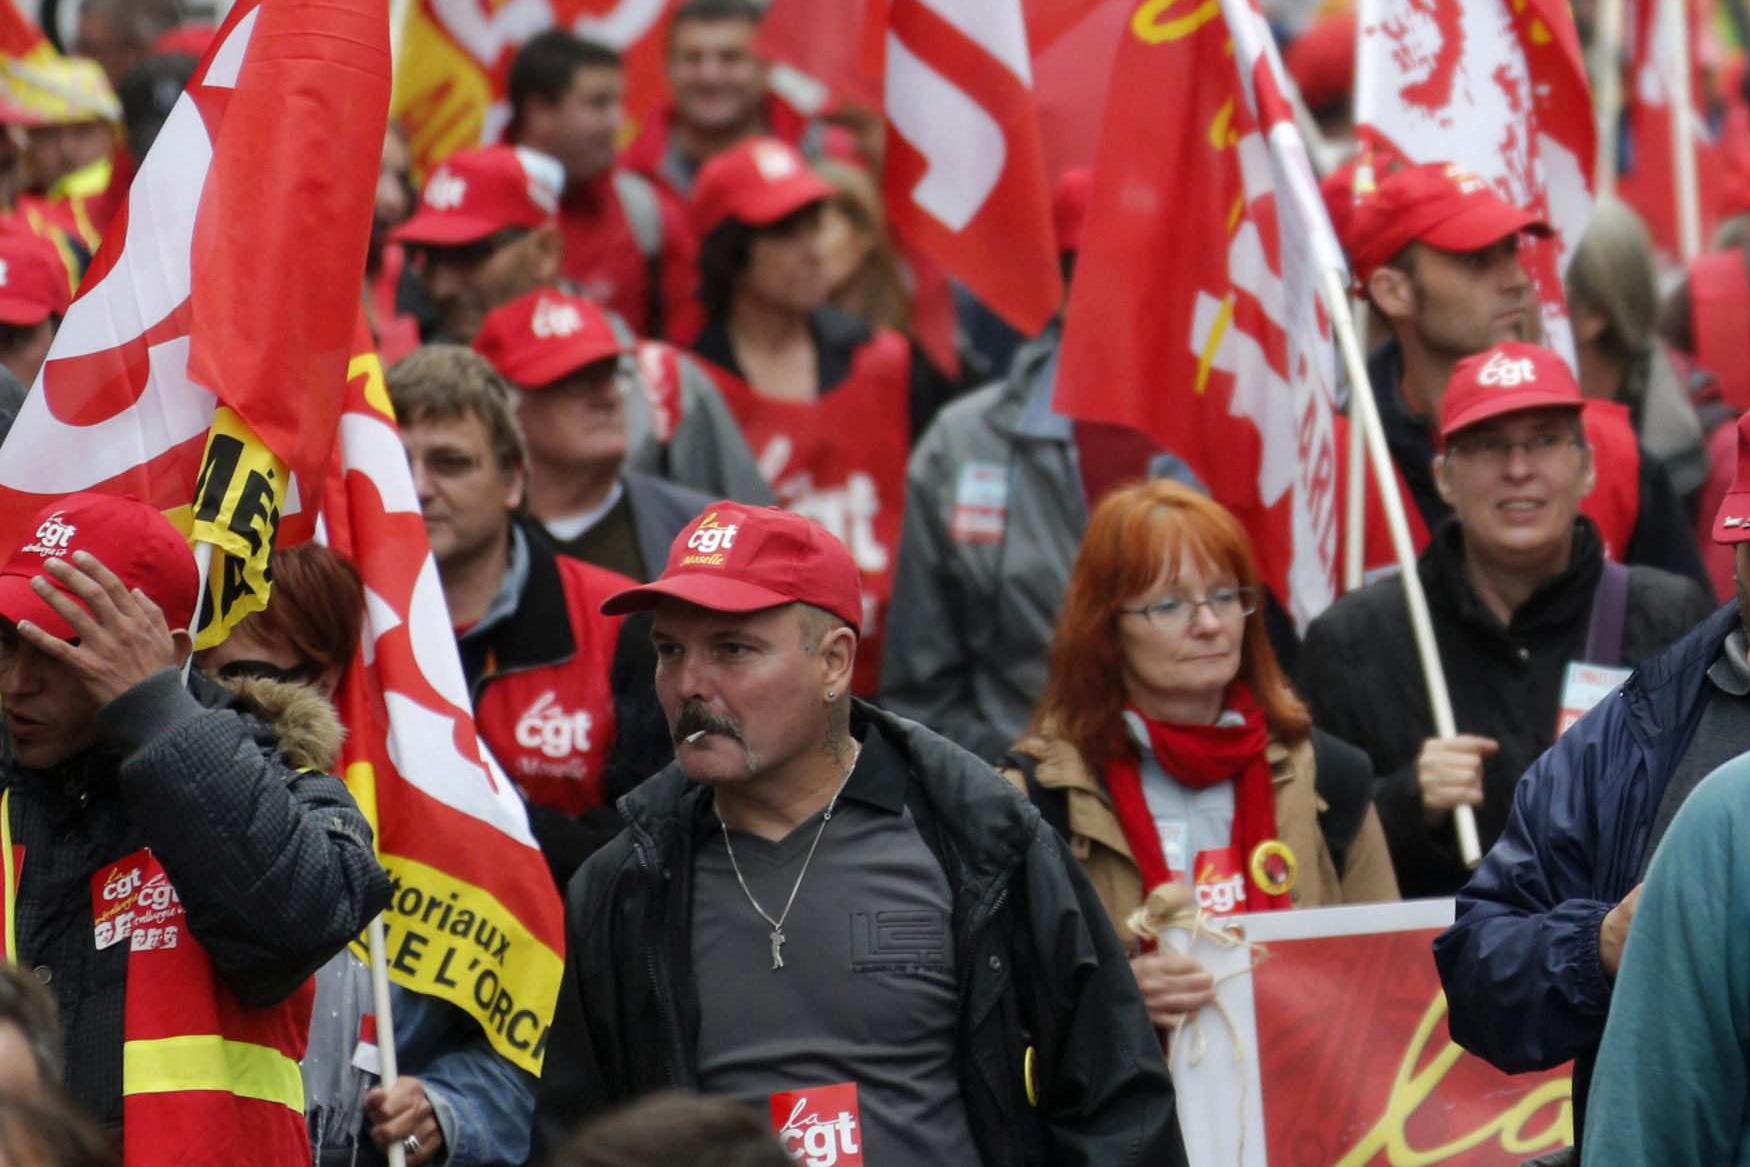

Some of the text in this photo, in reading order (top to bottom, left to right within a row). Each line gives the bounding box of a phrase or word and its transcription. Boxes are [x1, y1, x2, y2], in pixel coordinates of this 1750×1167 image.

[1478, 357, 1536, 388] cgt
[35, 520, 77, 547] cgt
[687, 524, 738, 553] cgt
[514, 709, 593, 758] cgt
[103, 867, 142, 901] cgt
[1195, 873, 1247, 912] cgt
[779, 1097, 853, 1135] la
[778, 1111, 860, 1167] cgt
